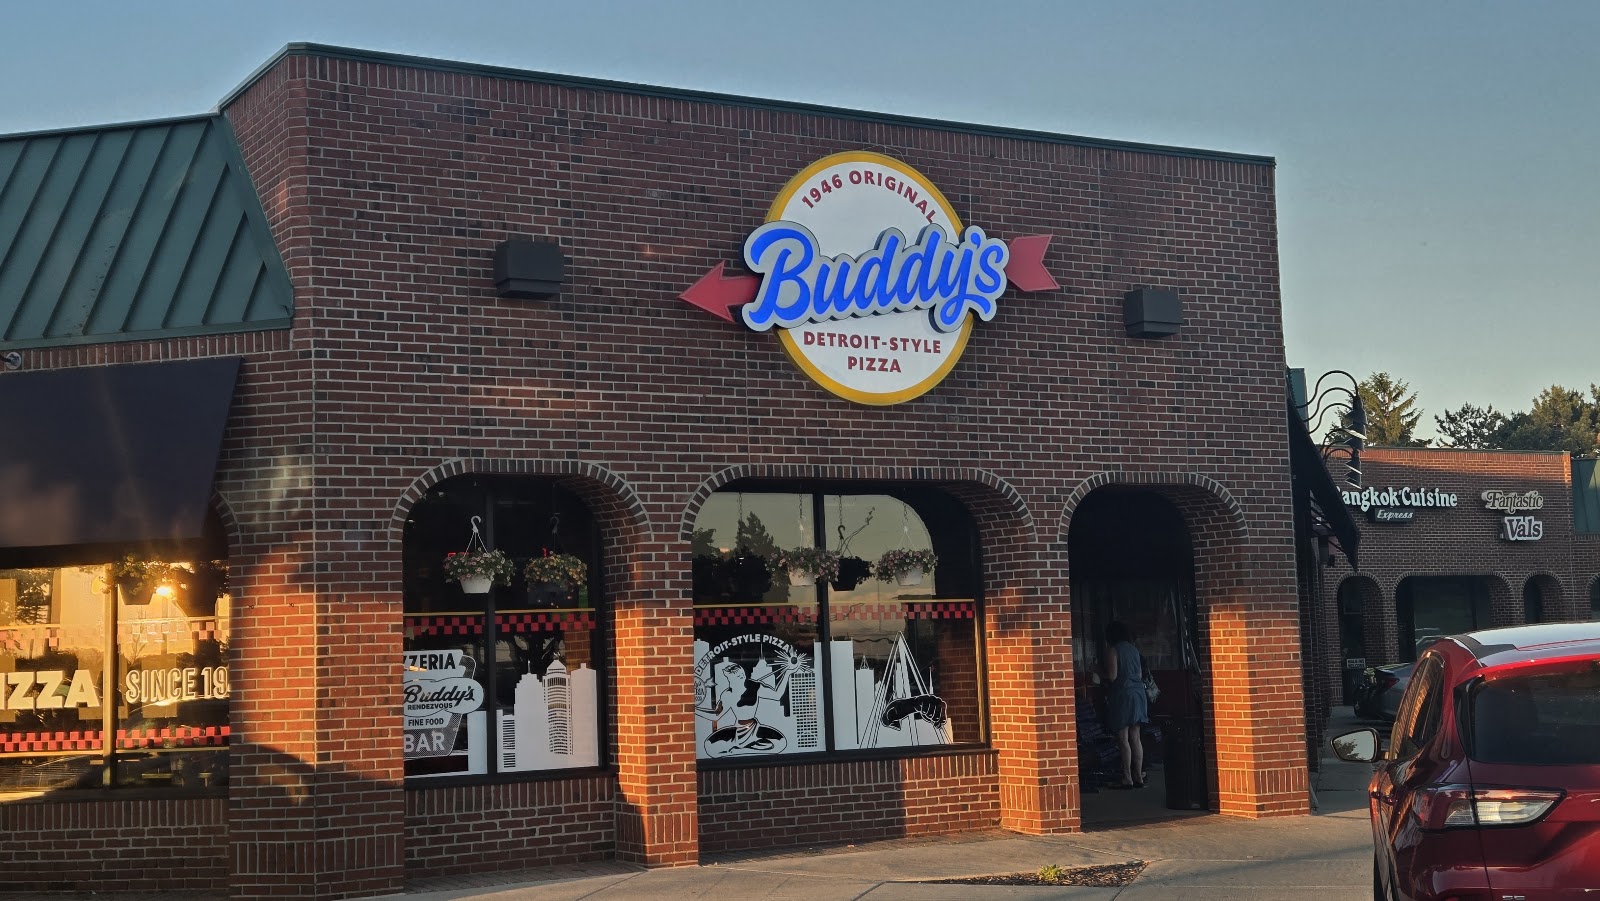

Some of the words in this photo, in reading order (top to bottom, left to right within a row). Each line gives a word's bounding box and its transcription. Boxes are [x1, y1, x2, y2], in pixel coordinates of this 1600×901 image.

[801, 173, 843, 209] 1946
[848, 170, 938, 224] ORIGINAL
[748, 227, 1004, 327] Buddy's
[803, 331, 942, 354] DETROIT-STYLE
[847, 357, 902, 373] PIZZA
[1336, 486, 1400, 512] angkok
[1401, 487, 1458, 507] Cuisine
[1485, 490, 1543, 514] Fantastic
[1376, 509, 1414, 521] Express
[1505, 517, 1542, 540] Vals
[694, 634, 761, 677] DETROIT-STYLE
[763, 635, 791, 653] PIZZA
[126, 667, 197, 704] SINCE
[200, 665, 231, 700] 19
[404, 684, 475, 708] Buddy's
[407, 702, 453, 711] RENDEZVOUS
[408, 718, 423, 727] FINE
[425, 717, 444, 726] FOOD
[404, 731, 445, 753] BAR
